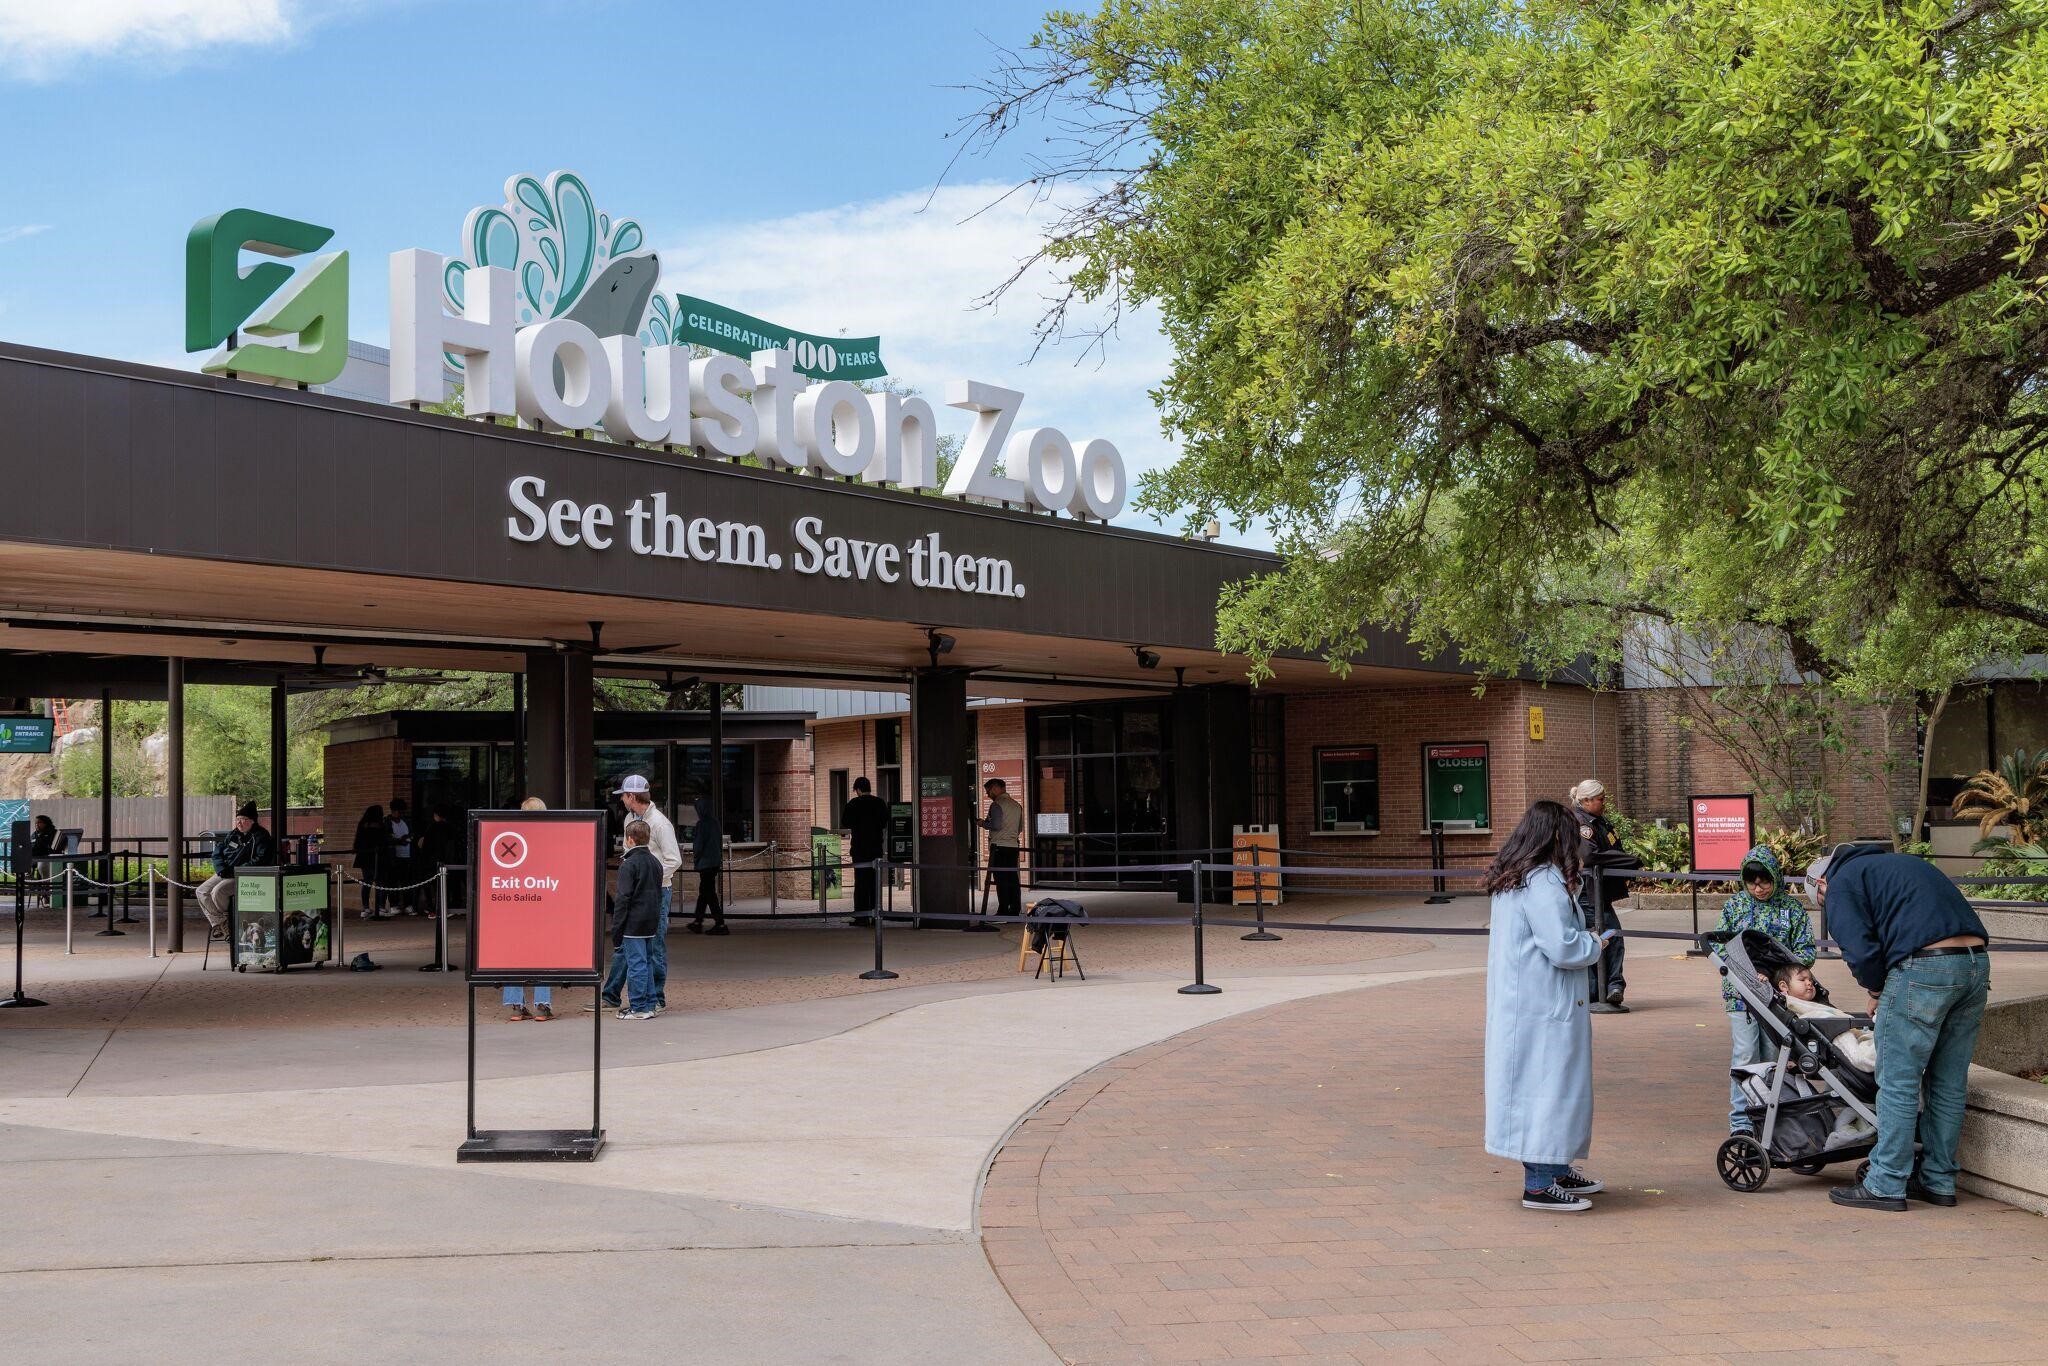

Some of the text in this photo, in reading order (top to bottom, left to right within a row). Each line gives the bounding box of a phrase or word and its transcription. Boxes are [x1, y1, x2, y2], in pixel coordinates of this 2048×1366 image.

[837, 351, 877, 366] YEARS
[390, 247, 1127, 520] Houston Zoo
[507, 475, 1026, 599] See them. Save them.
[1531, 712, 1542, 721] GATE
[1533, 724, 1541, 734] 10
[1437, 757, 1483, 768] CLOSED
[1236, 853, 1247, 861] All
[491, 876, 559, 891] Exit Only
[514, 893, 542, 901] Salida
